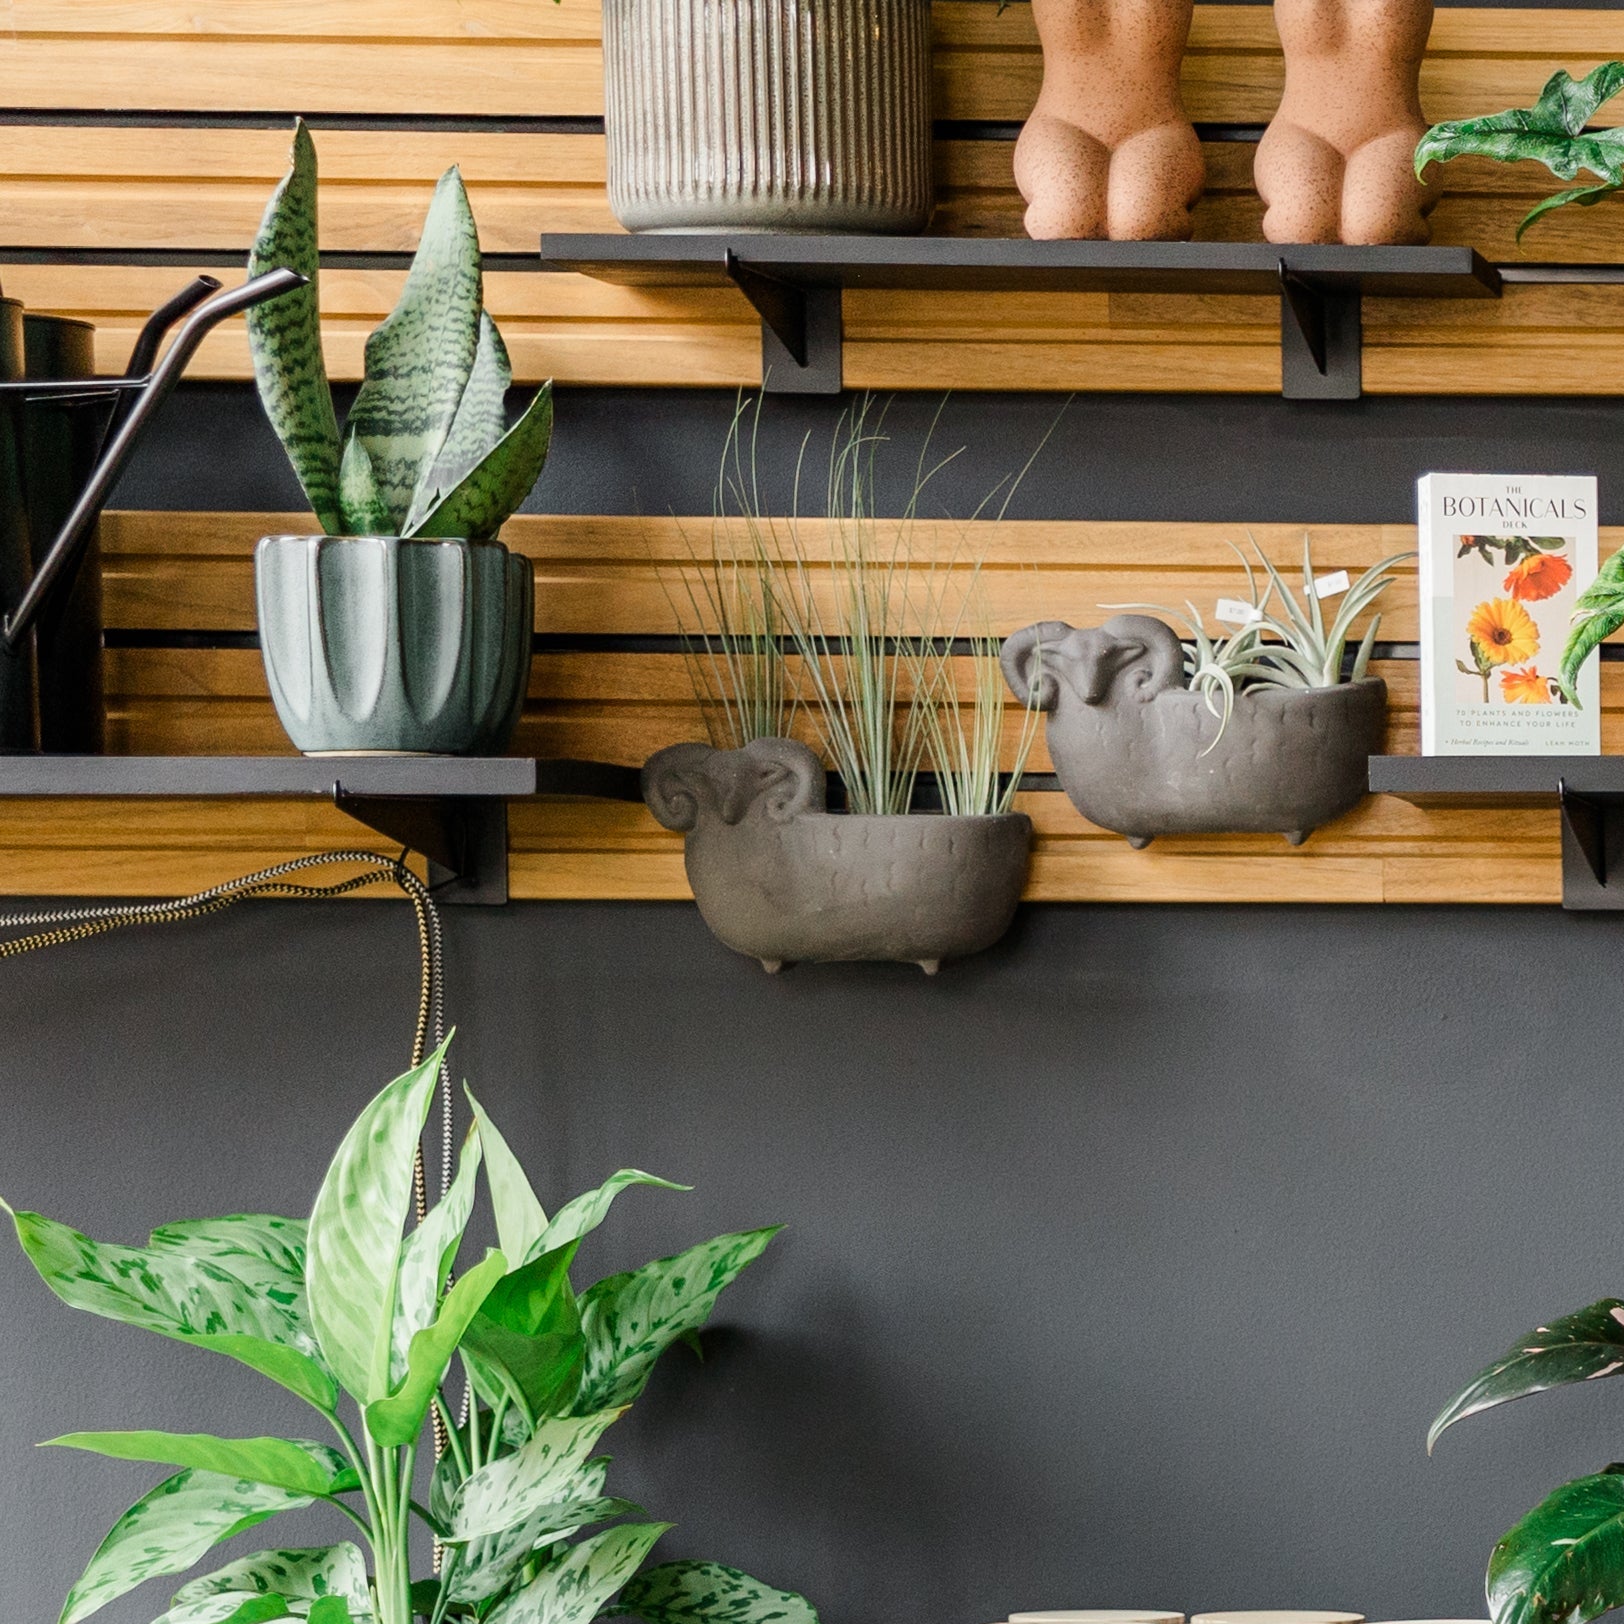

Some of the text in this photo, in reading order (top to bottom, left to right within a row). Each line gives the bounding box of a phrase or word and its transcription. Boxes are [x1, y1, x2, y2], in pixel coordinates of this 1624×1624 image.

[1506, 486, 1521, 494] THE
[1443, 496, 1587, 520] BOTANICALS
[1502, 521, 1528, 529] DECK
